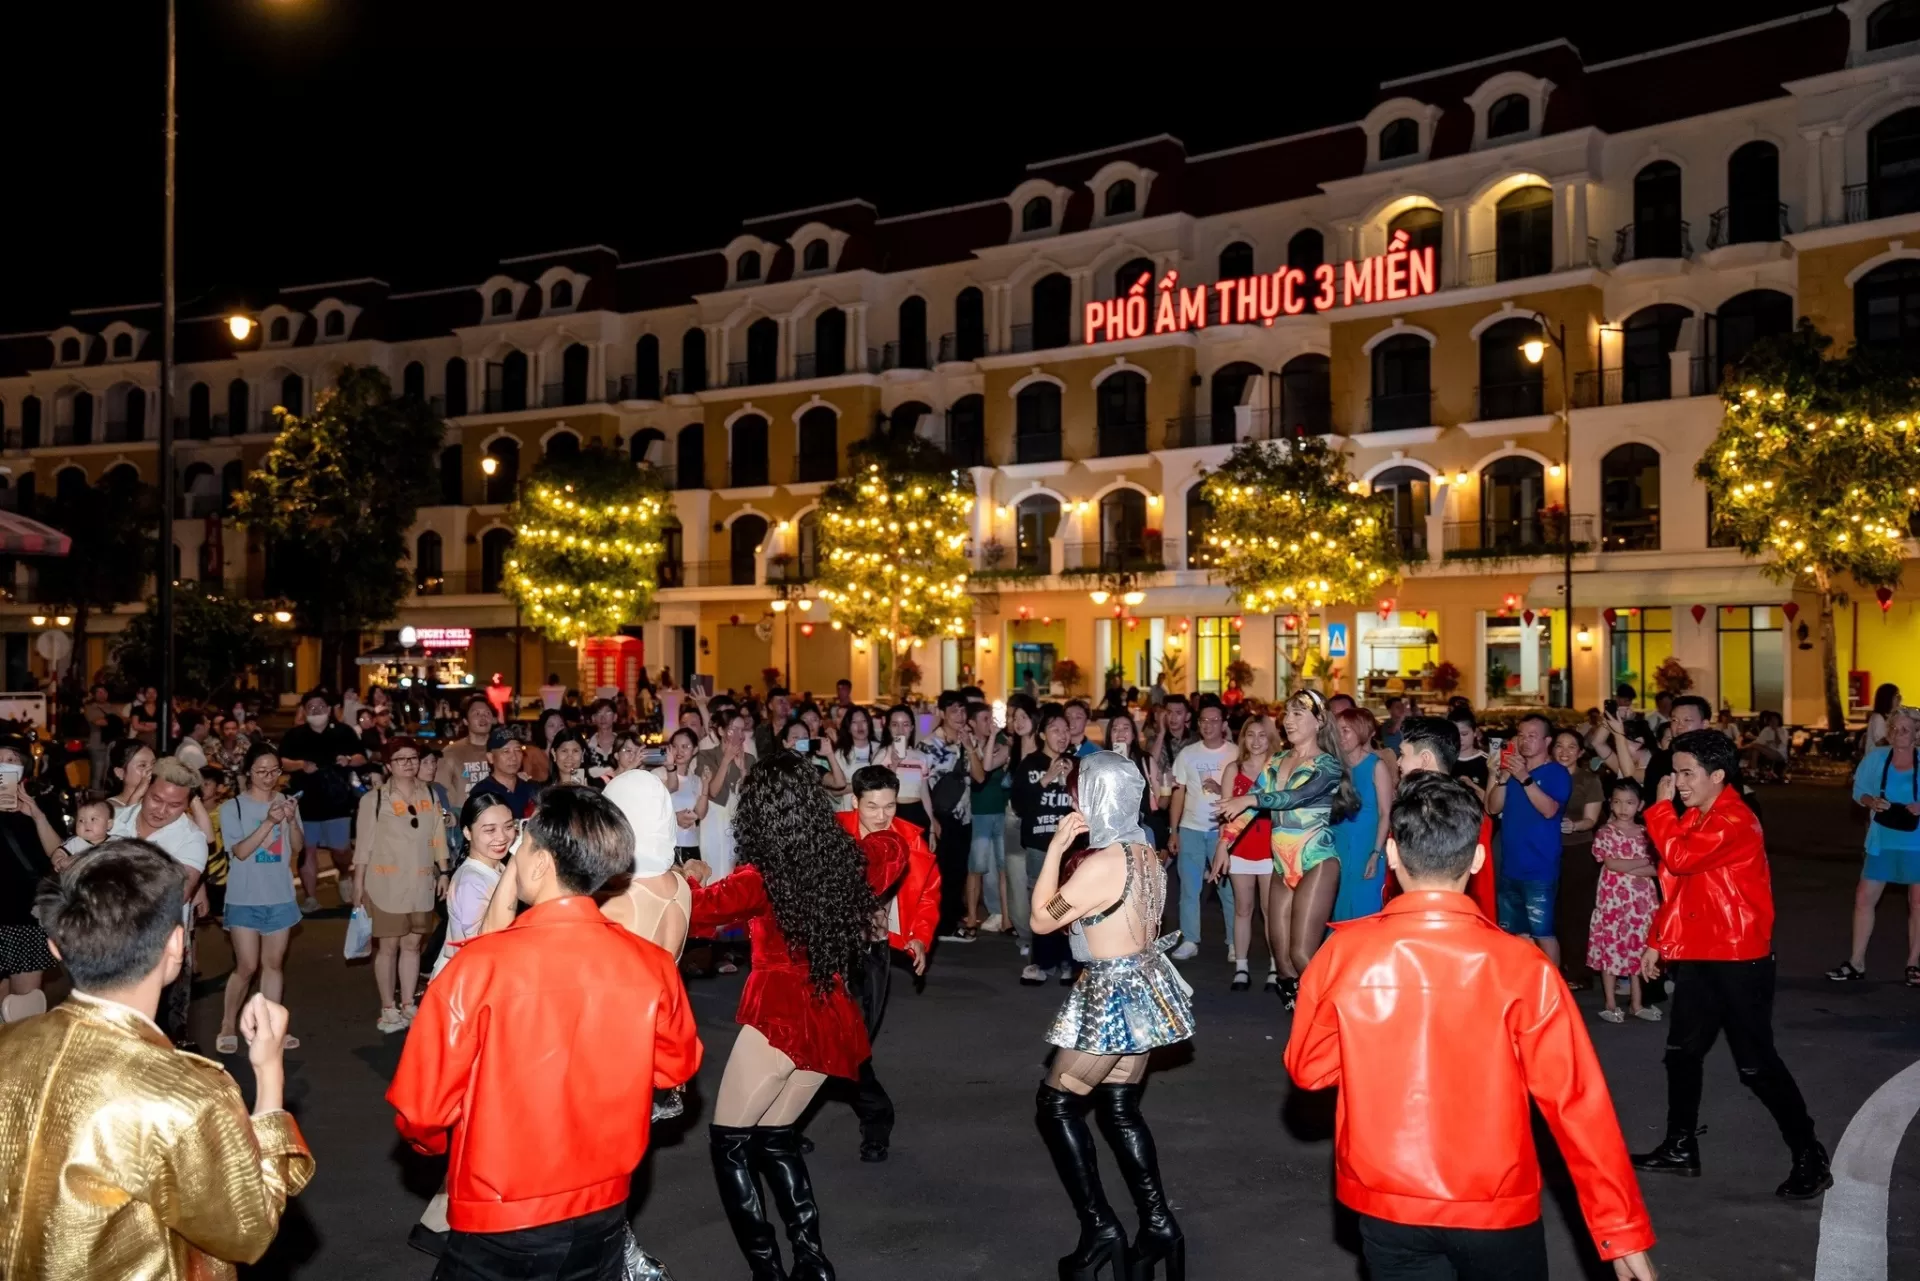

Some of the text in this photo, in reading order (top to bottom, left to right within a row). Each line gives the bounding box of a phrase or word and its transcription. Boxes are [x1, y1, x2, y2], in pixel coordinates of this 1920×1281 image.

[1084, 271, 1151, 344] PHỐ
[1215, 265, 1306, 327] THỰC
[1314, 263, 1336, 311] 3
[1343, 229, 1436, 306] MIỀN
[416, 629, 472, 639] NIGHT CHILL
[463, 761, 481, 773] THIS
